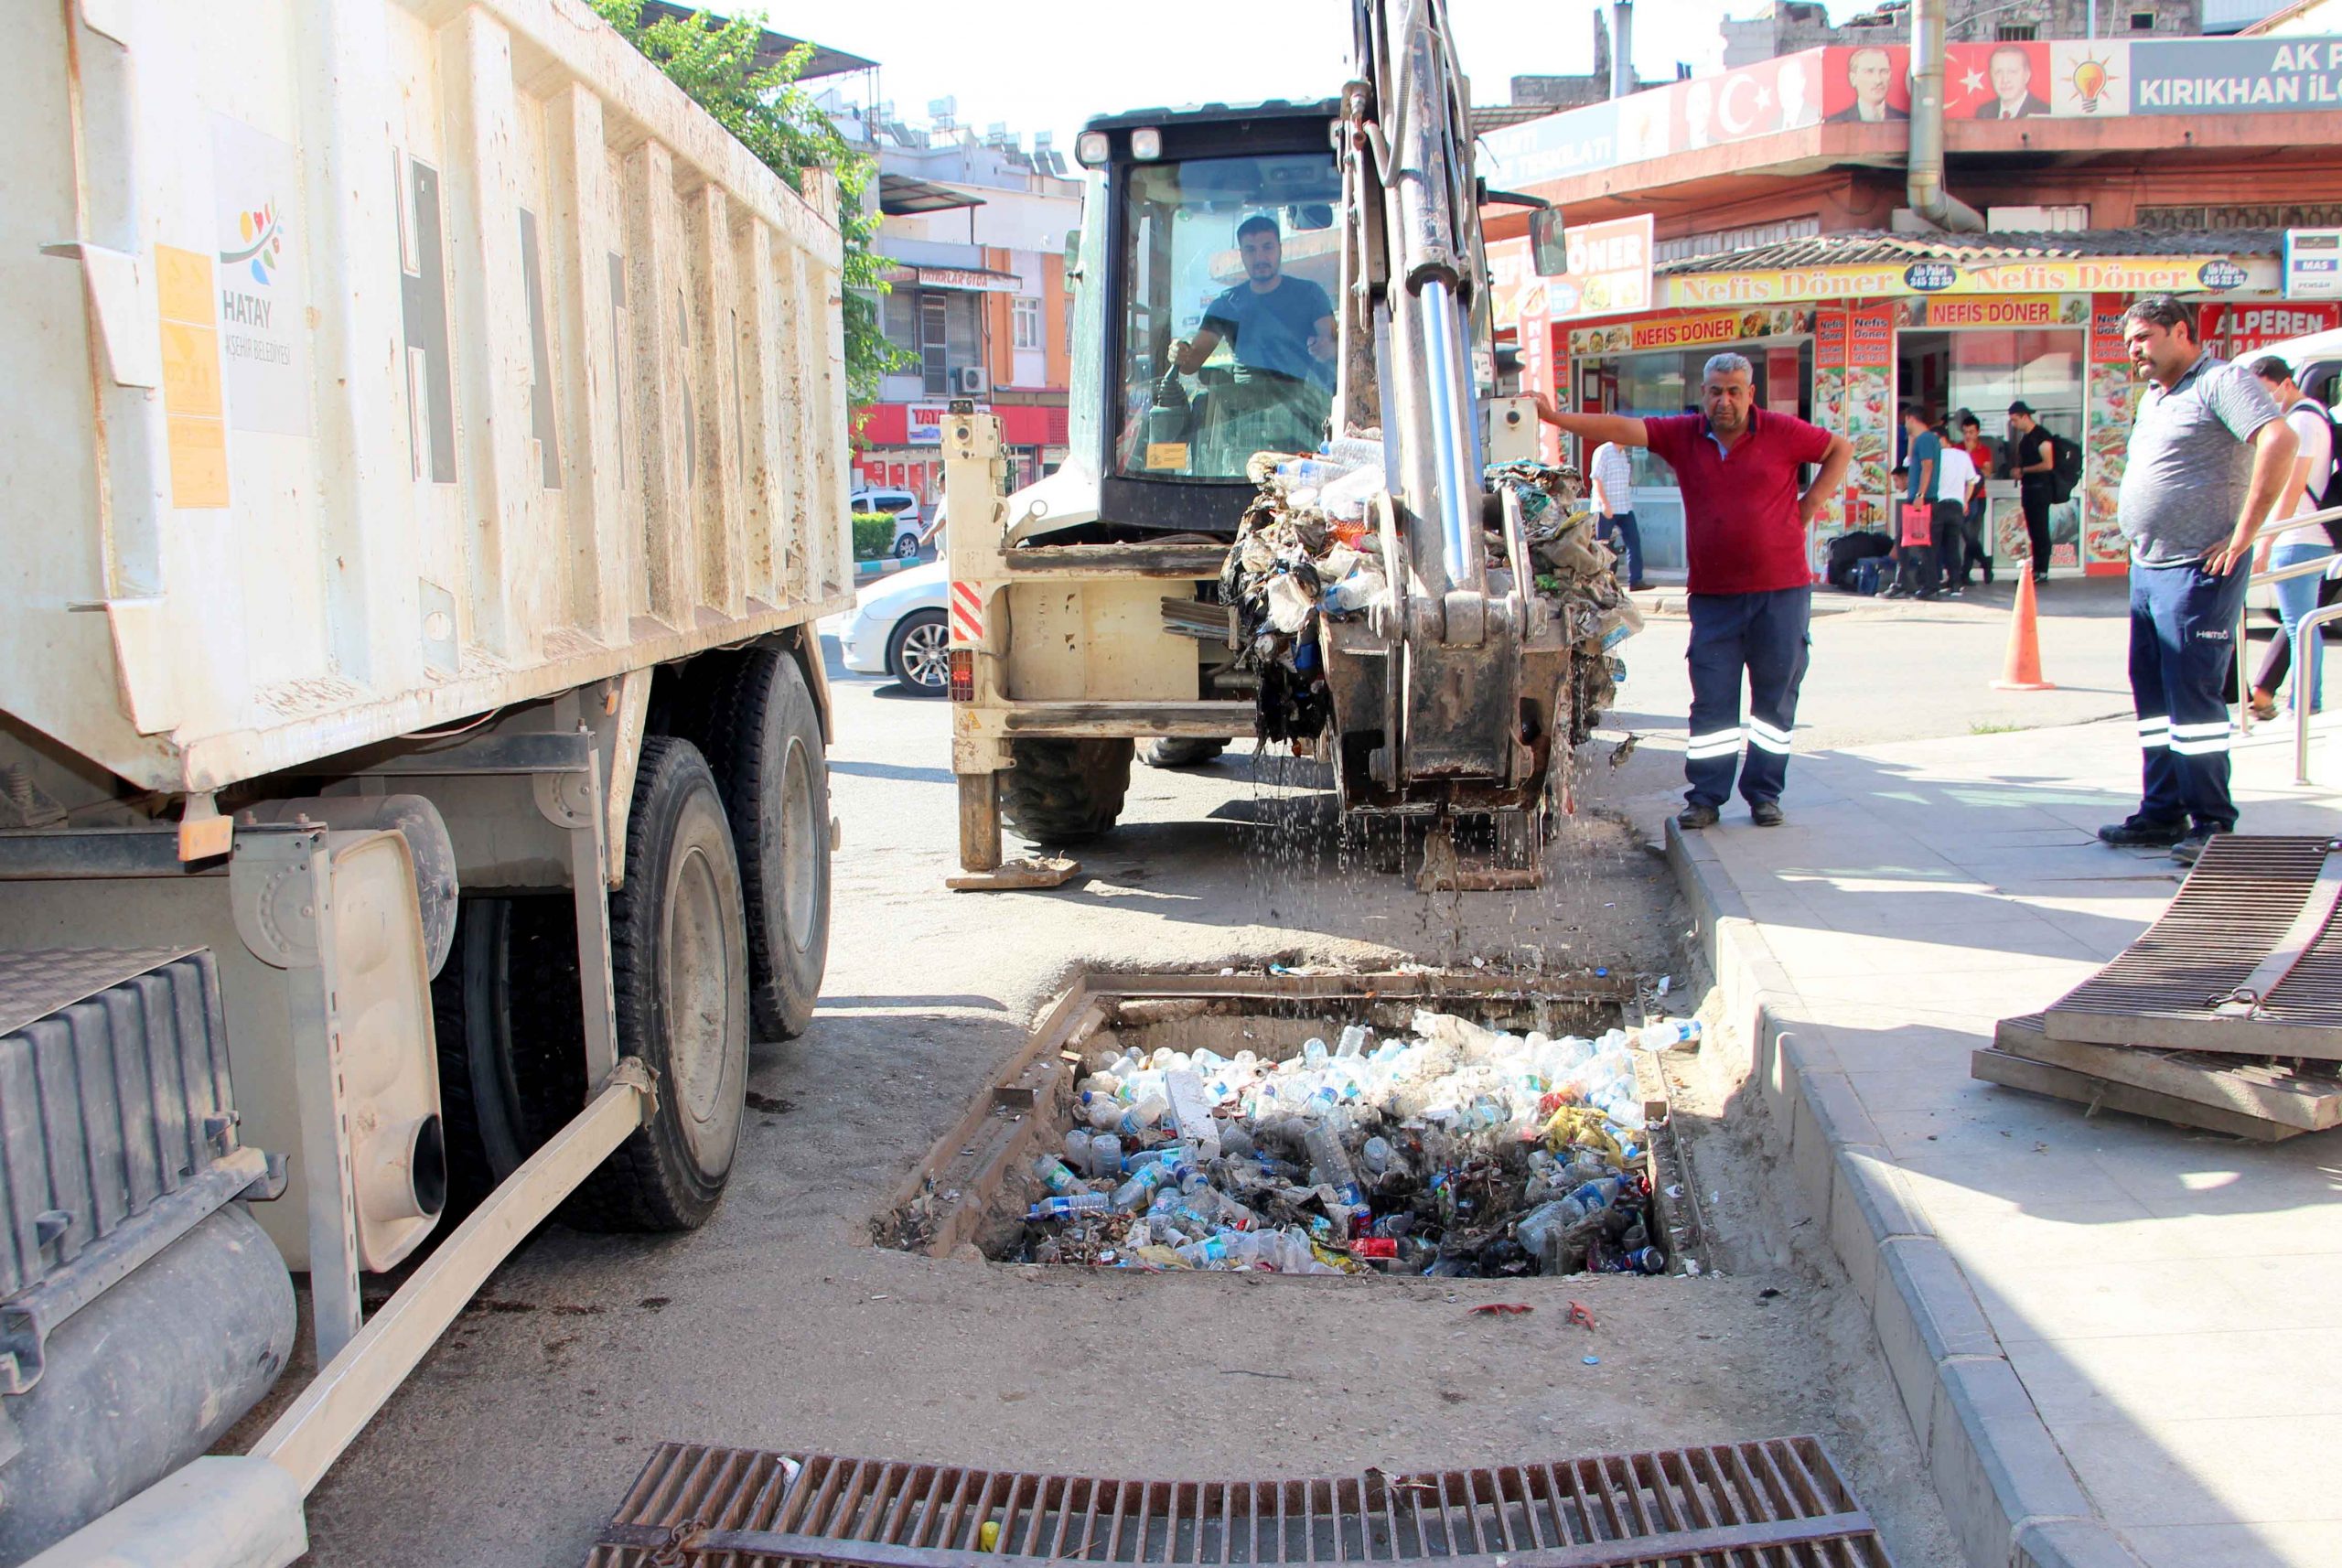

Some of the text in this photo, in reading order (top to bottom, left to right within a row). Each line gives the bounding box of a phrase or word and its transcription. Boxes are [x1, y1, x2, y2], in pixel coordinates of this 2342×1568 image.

[2271, 44, 2320, 72] AK
[2139, 76, 2299, 106] KIRIKHAN
[1567, 233, 1642, 275] ÖNER
[2302, 262, 2329, 271] MAS
[1681, 269, 1894, 303] Nefis Döner
[1975, 260, 2187, 292] Nefis Döner
[223, 289, 272, 330] HATAY
[1933, 297, 2050, 323] NEFİS DÖNER
[2214, 309, 2324, 336] ALPEREN
[1636, 317, 1734, 346] NEFİS DÖNER
[252, 338, 291, 367] BELEDİYESİ
